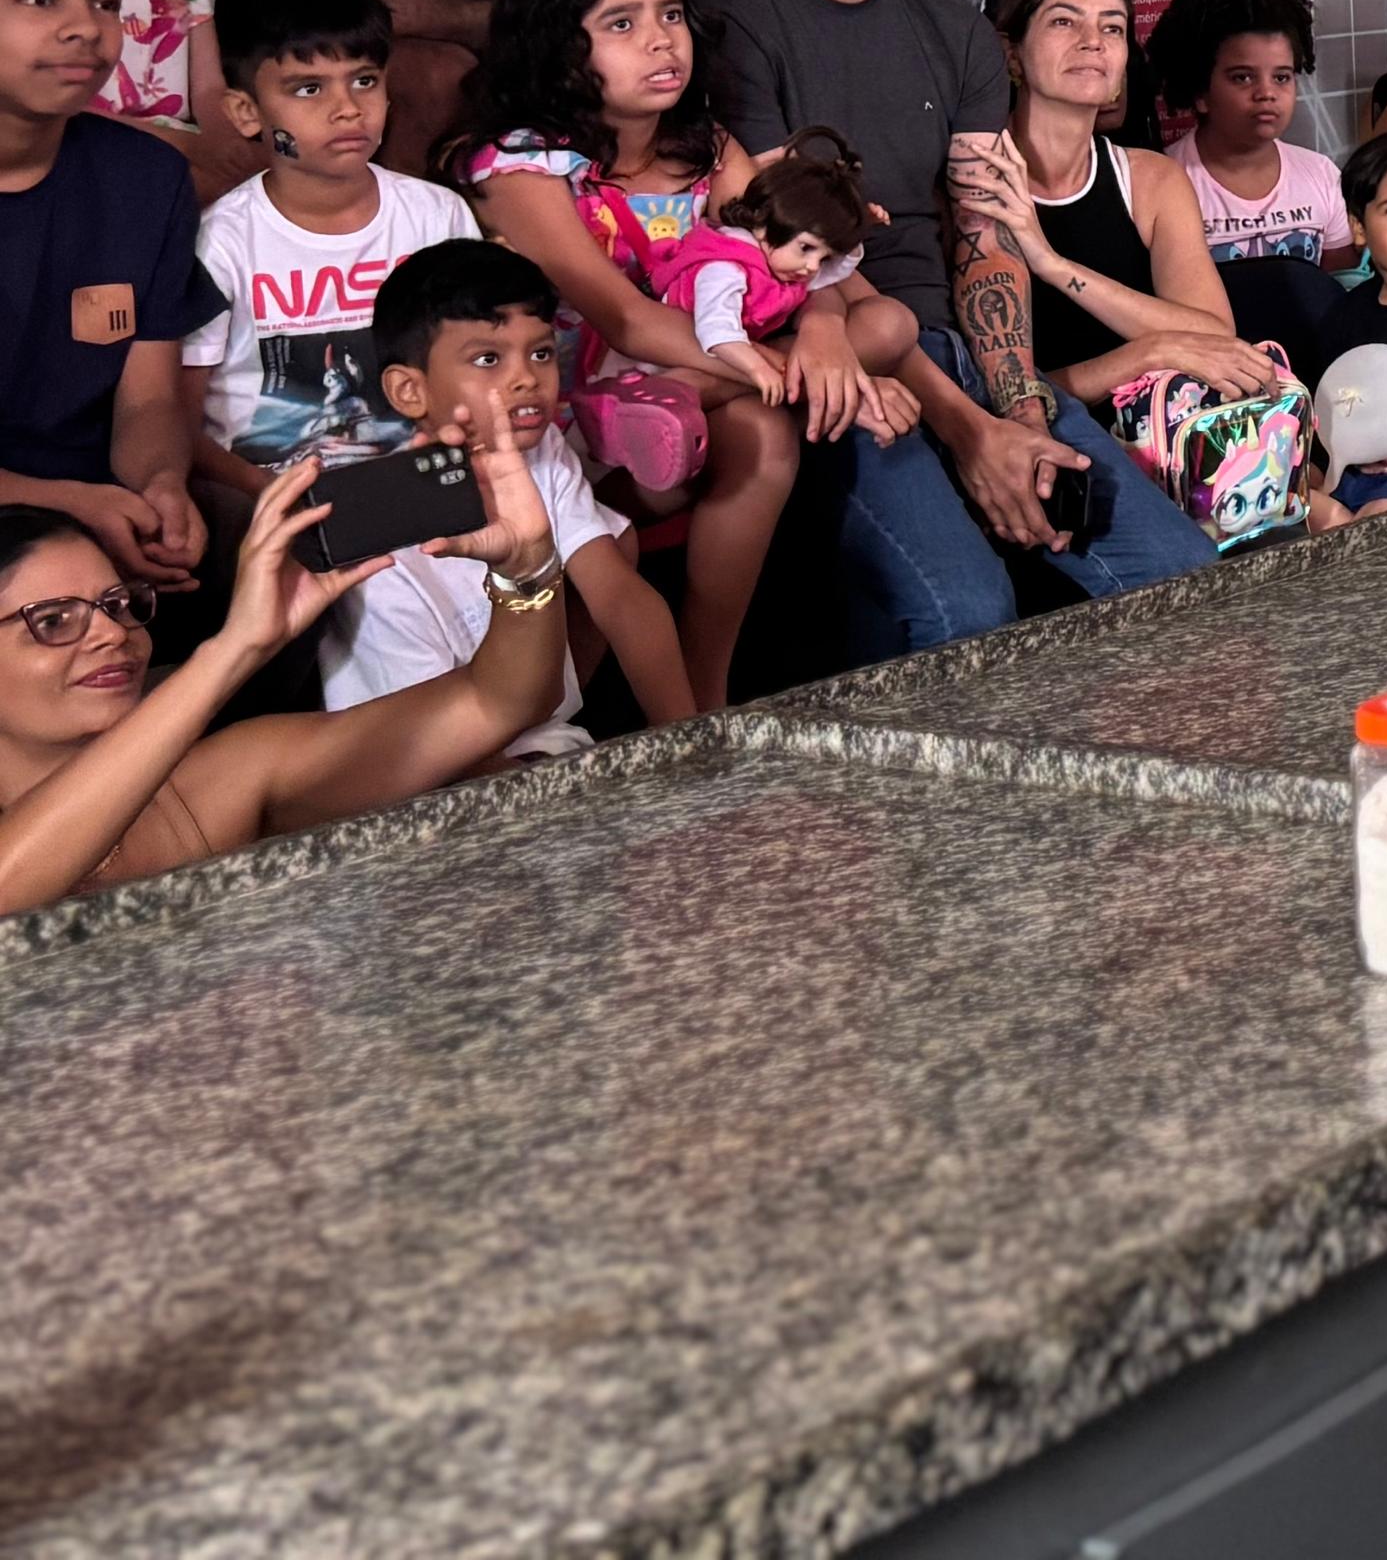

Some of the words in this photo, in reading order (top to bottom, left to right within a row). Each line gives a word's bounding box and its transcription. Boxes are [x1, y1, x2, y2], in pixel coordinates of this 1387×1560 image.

[1204, 214, 1266, 235] STITCH
[1272, 211, 1285, 225] IS
[1290, 206, 1312, 222] MY
[253, 255, 411, 321] NAS
